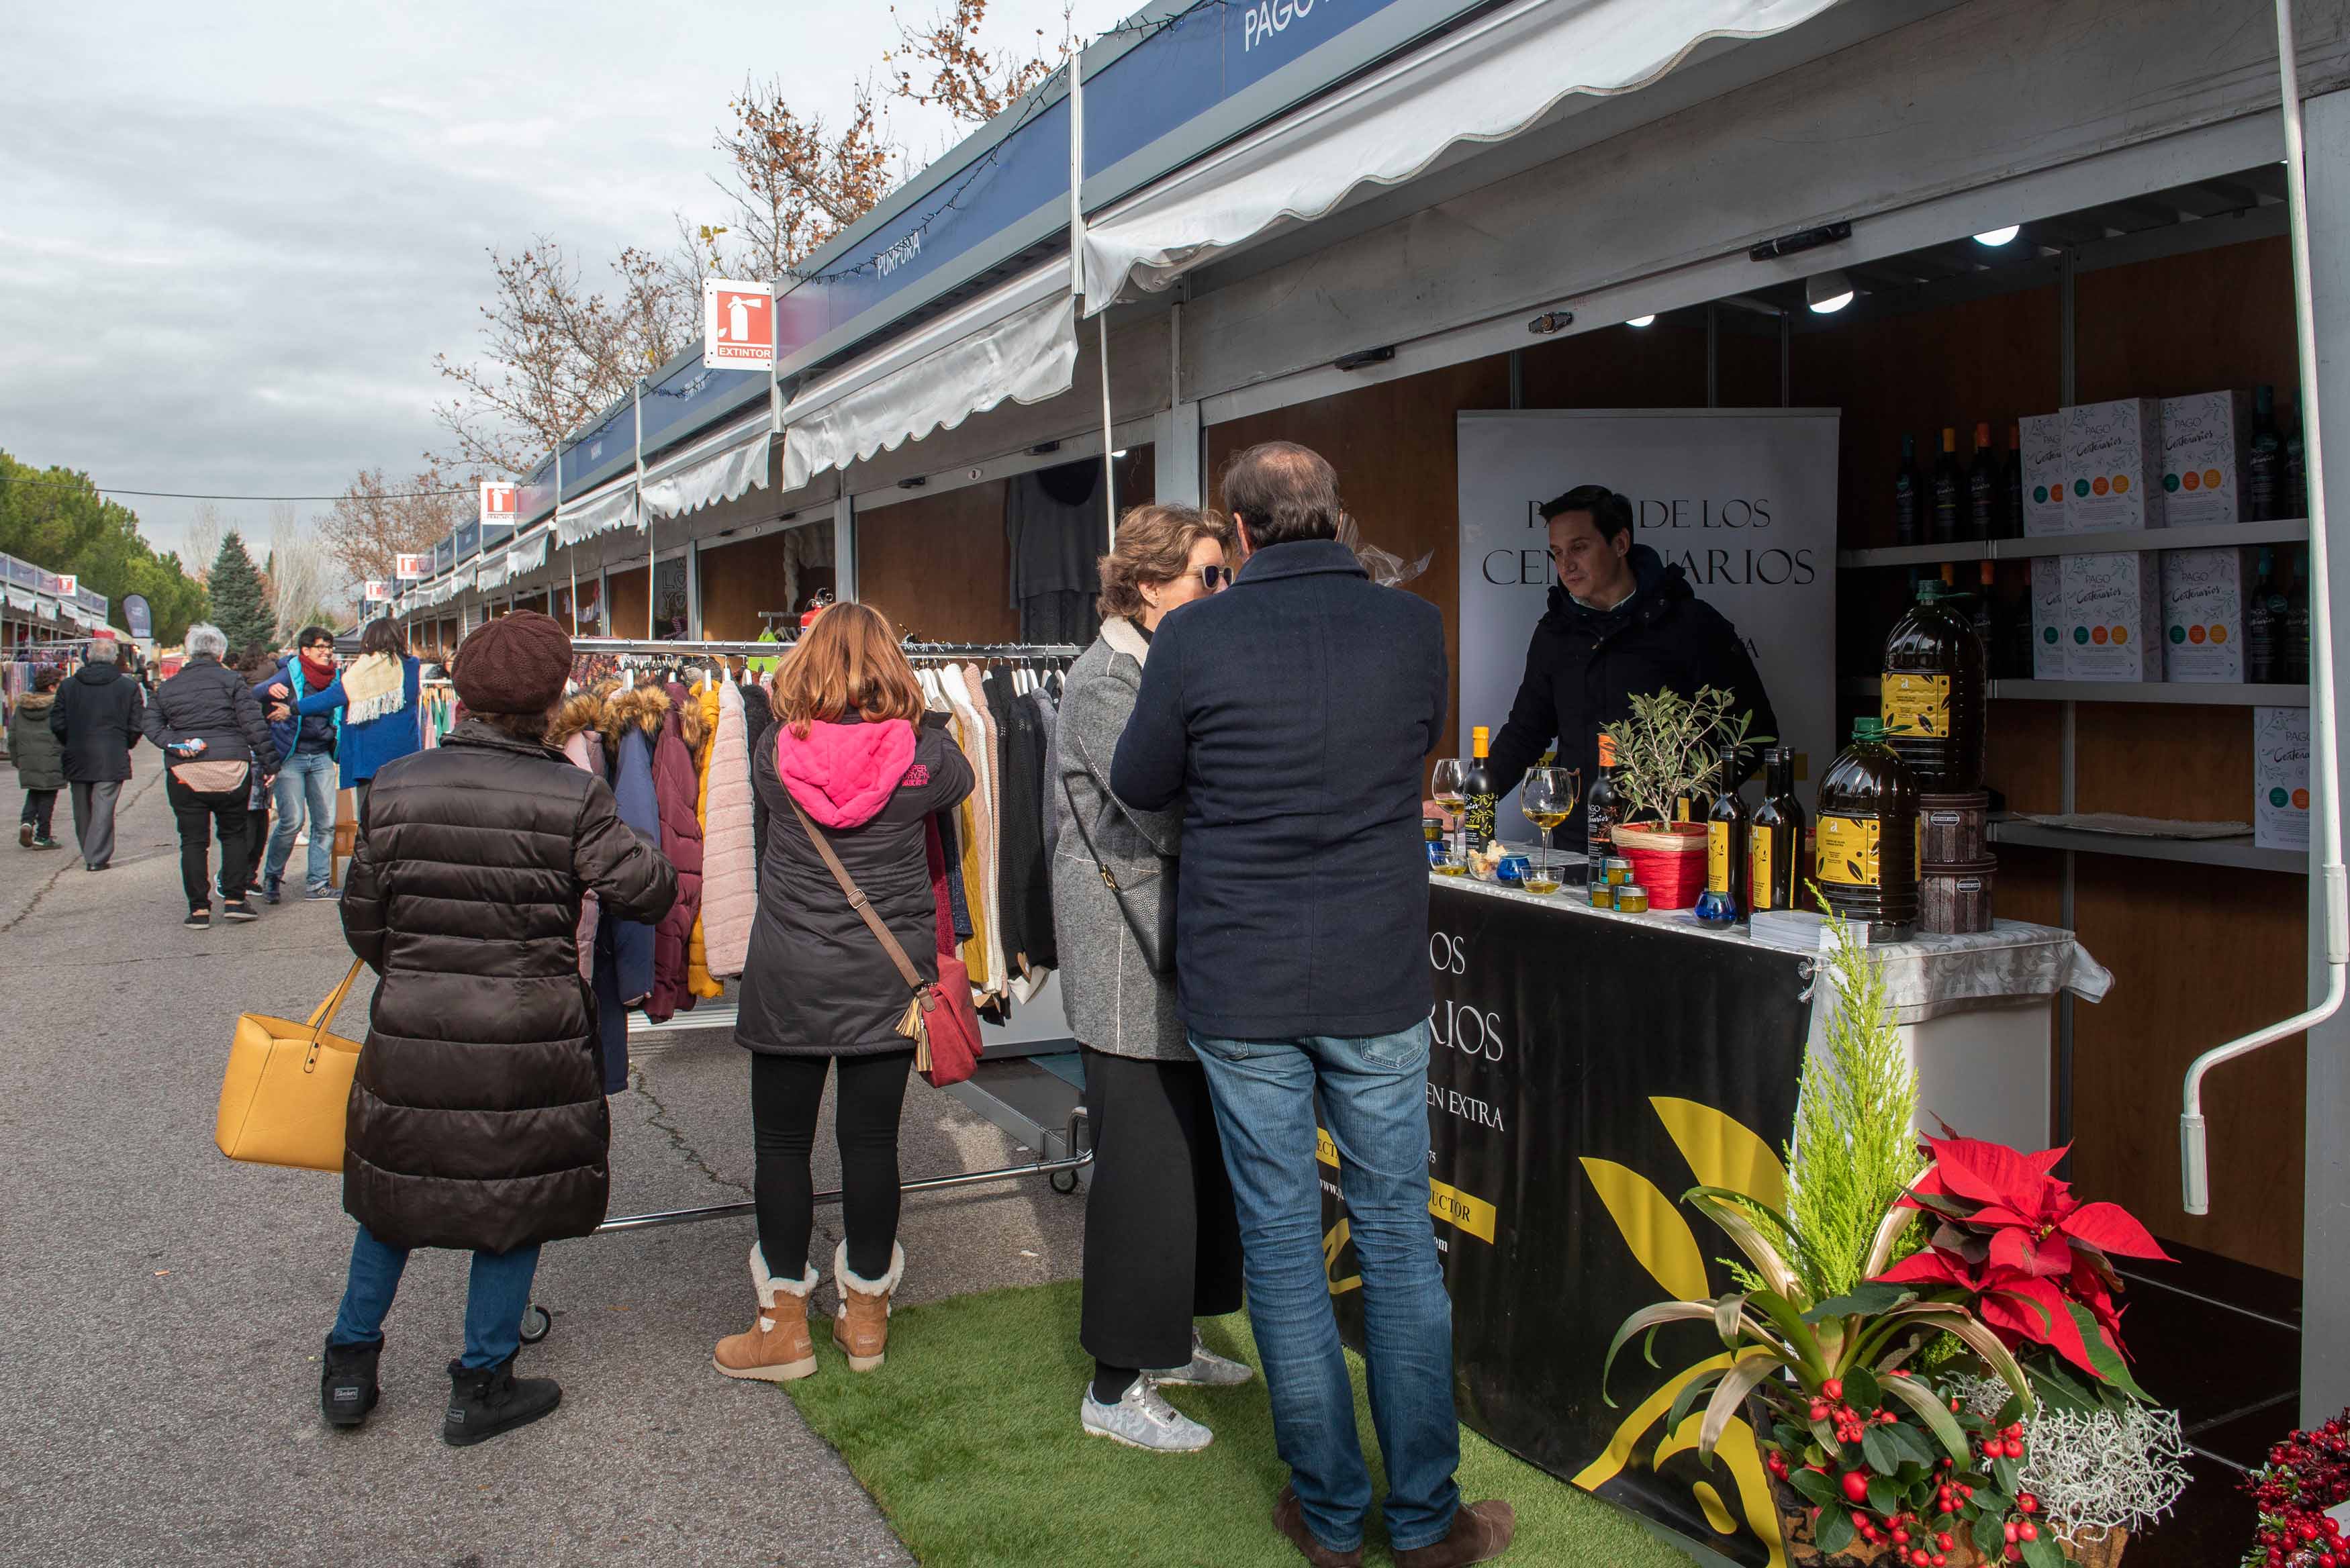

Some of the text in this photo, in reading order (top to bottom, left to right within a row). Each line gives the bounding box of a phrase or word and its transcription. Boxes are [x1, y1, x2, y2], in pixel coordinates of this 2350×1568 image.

[718, 347, 771, 358] EXTINTOR
[2085, 424, 2111, 435] PAGO
[2175, 418, 2202, 430] PAGO
[1640, 499, 1771, 528] DE LOS
[2085, 574, 2110, 583] PAGO
[2182, 571, 2208, 582] PAGO
[1449, 1089, 1504, 1132] EXTRA
